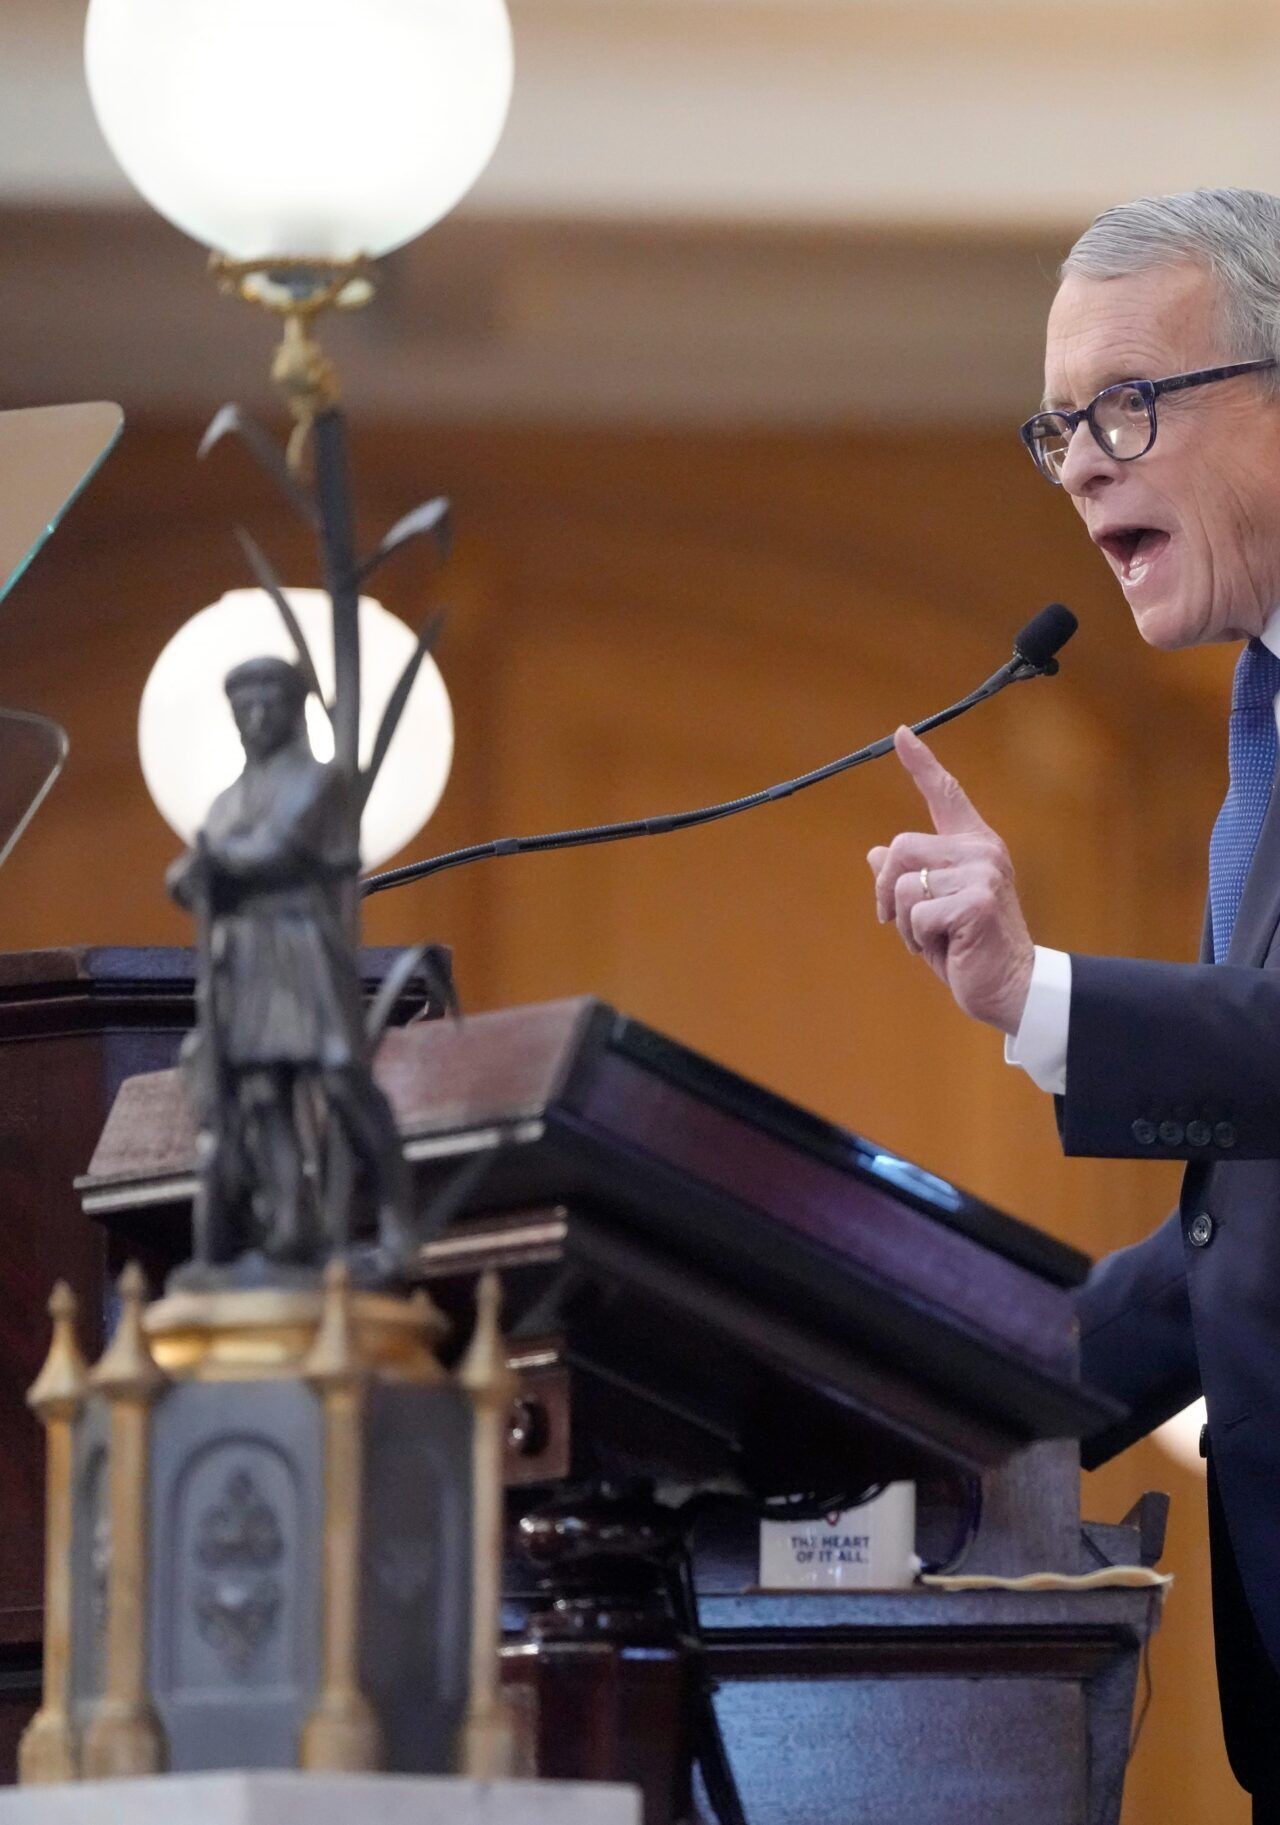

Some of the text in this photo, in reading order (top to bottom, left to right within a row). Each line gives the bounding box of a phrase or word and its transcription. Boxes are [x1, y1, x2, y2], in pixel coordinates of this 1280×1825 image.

[822, 1536, 870, 1548] HEART
[796, 1551, 814, 1563] OF
[819, 1551, 833, 1562] IT
